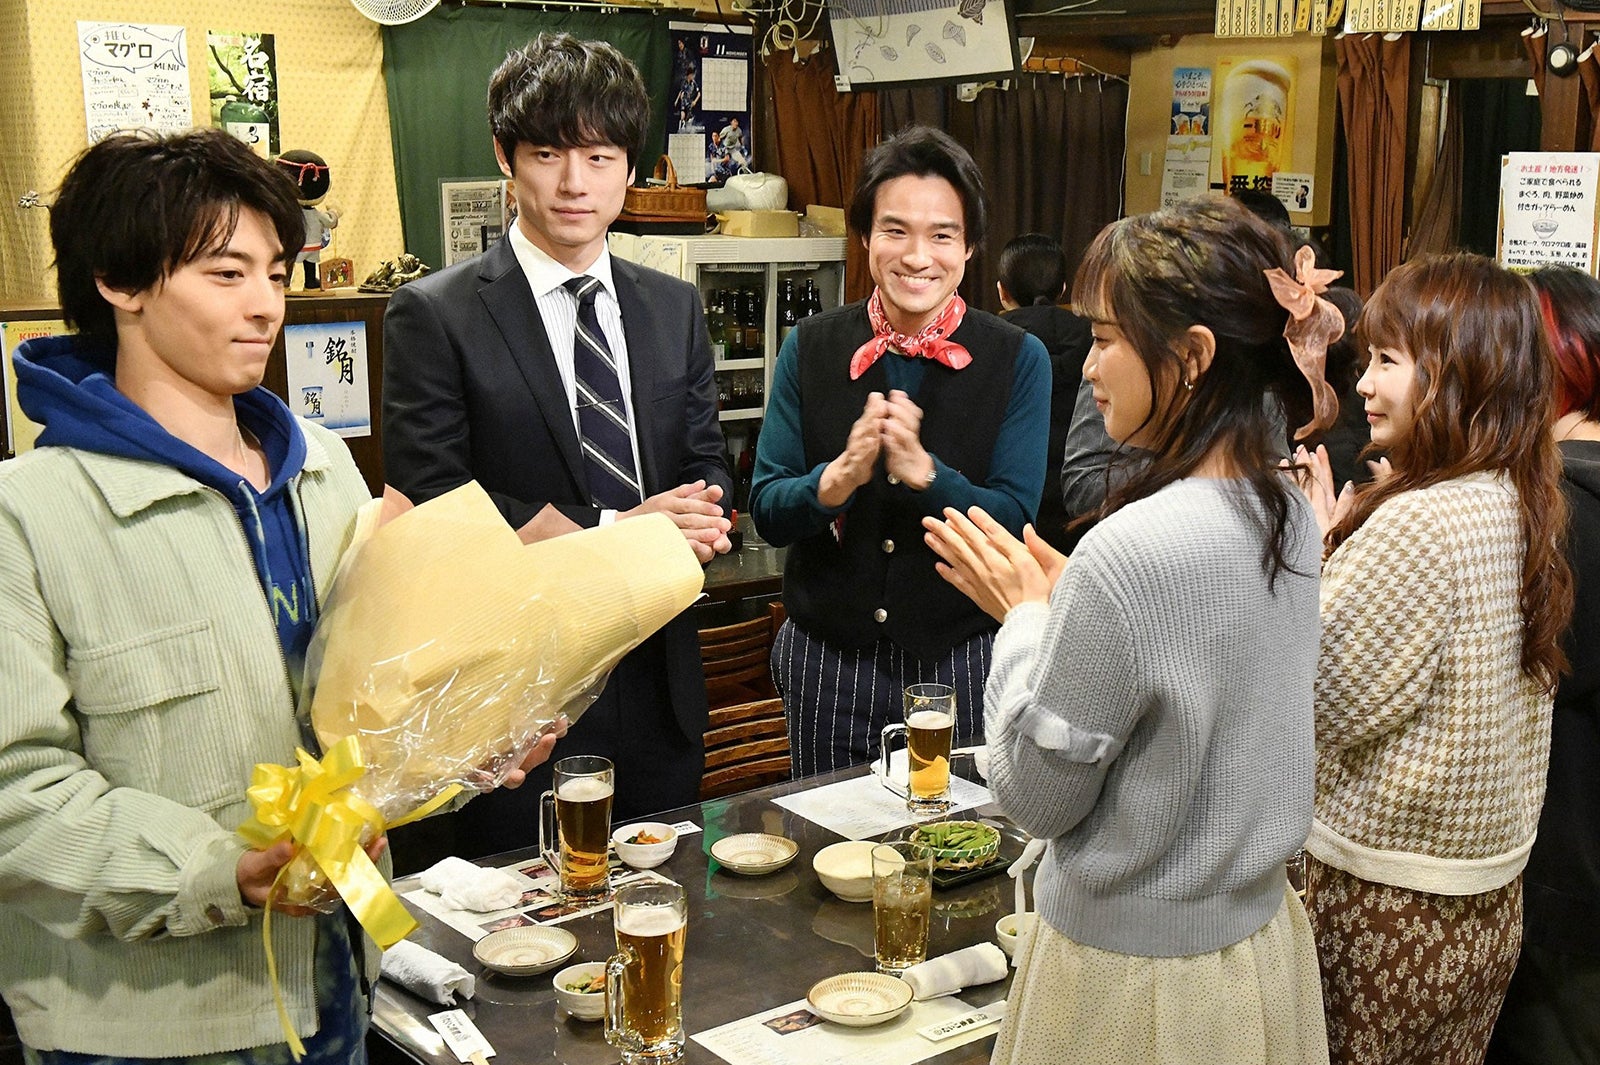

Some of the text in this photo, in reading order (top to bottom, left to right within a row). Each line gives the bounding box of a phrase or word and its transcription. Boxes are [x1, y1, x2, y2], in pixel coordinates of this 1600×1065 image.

[104, 31, 132, 41] 推し
[104, 43, 152, 58] マグロ
[716, 44, 726, 56] 11
[153, 62, 180, 71] MENU
[1519, 177, 1582, 187] ご家庭で食べられる
[1517, 203, 1576, 213] 付きガッツらーめん
[324, 337, 354, 385] 銘月
[304, 392, 320, 414] 銘月
